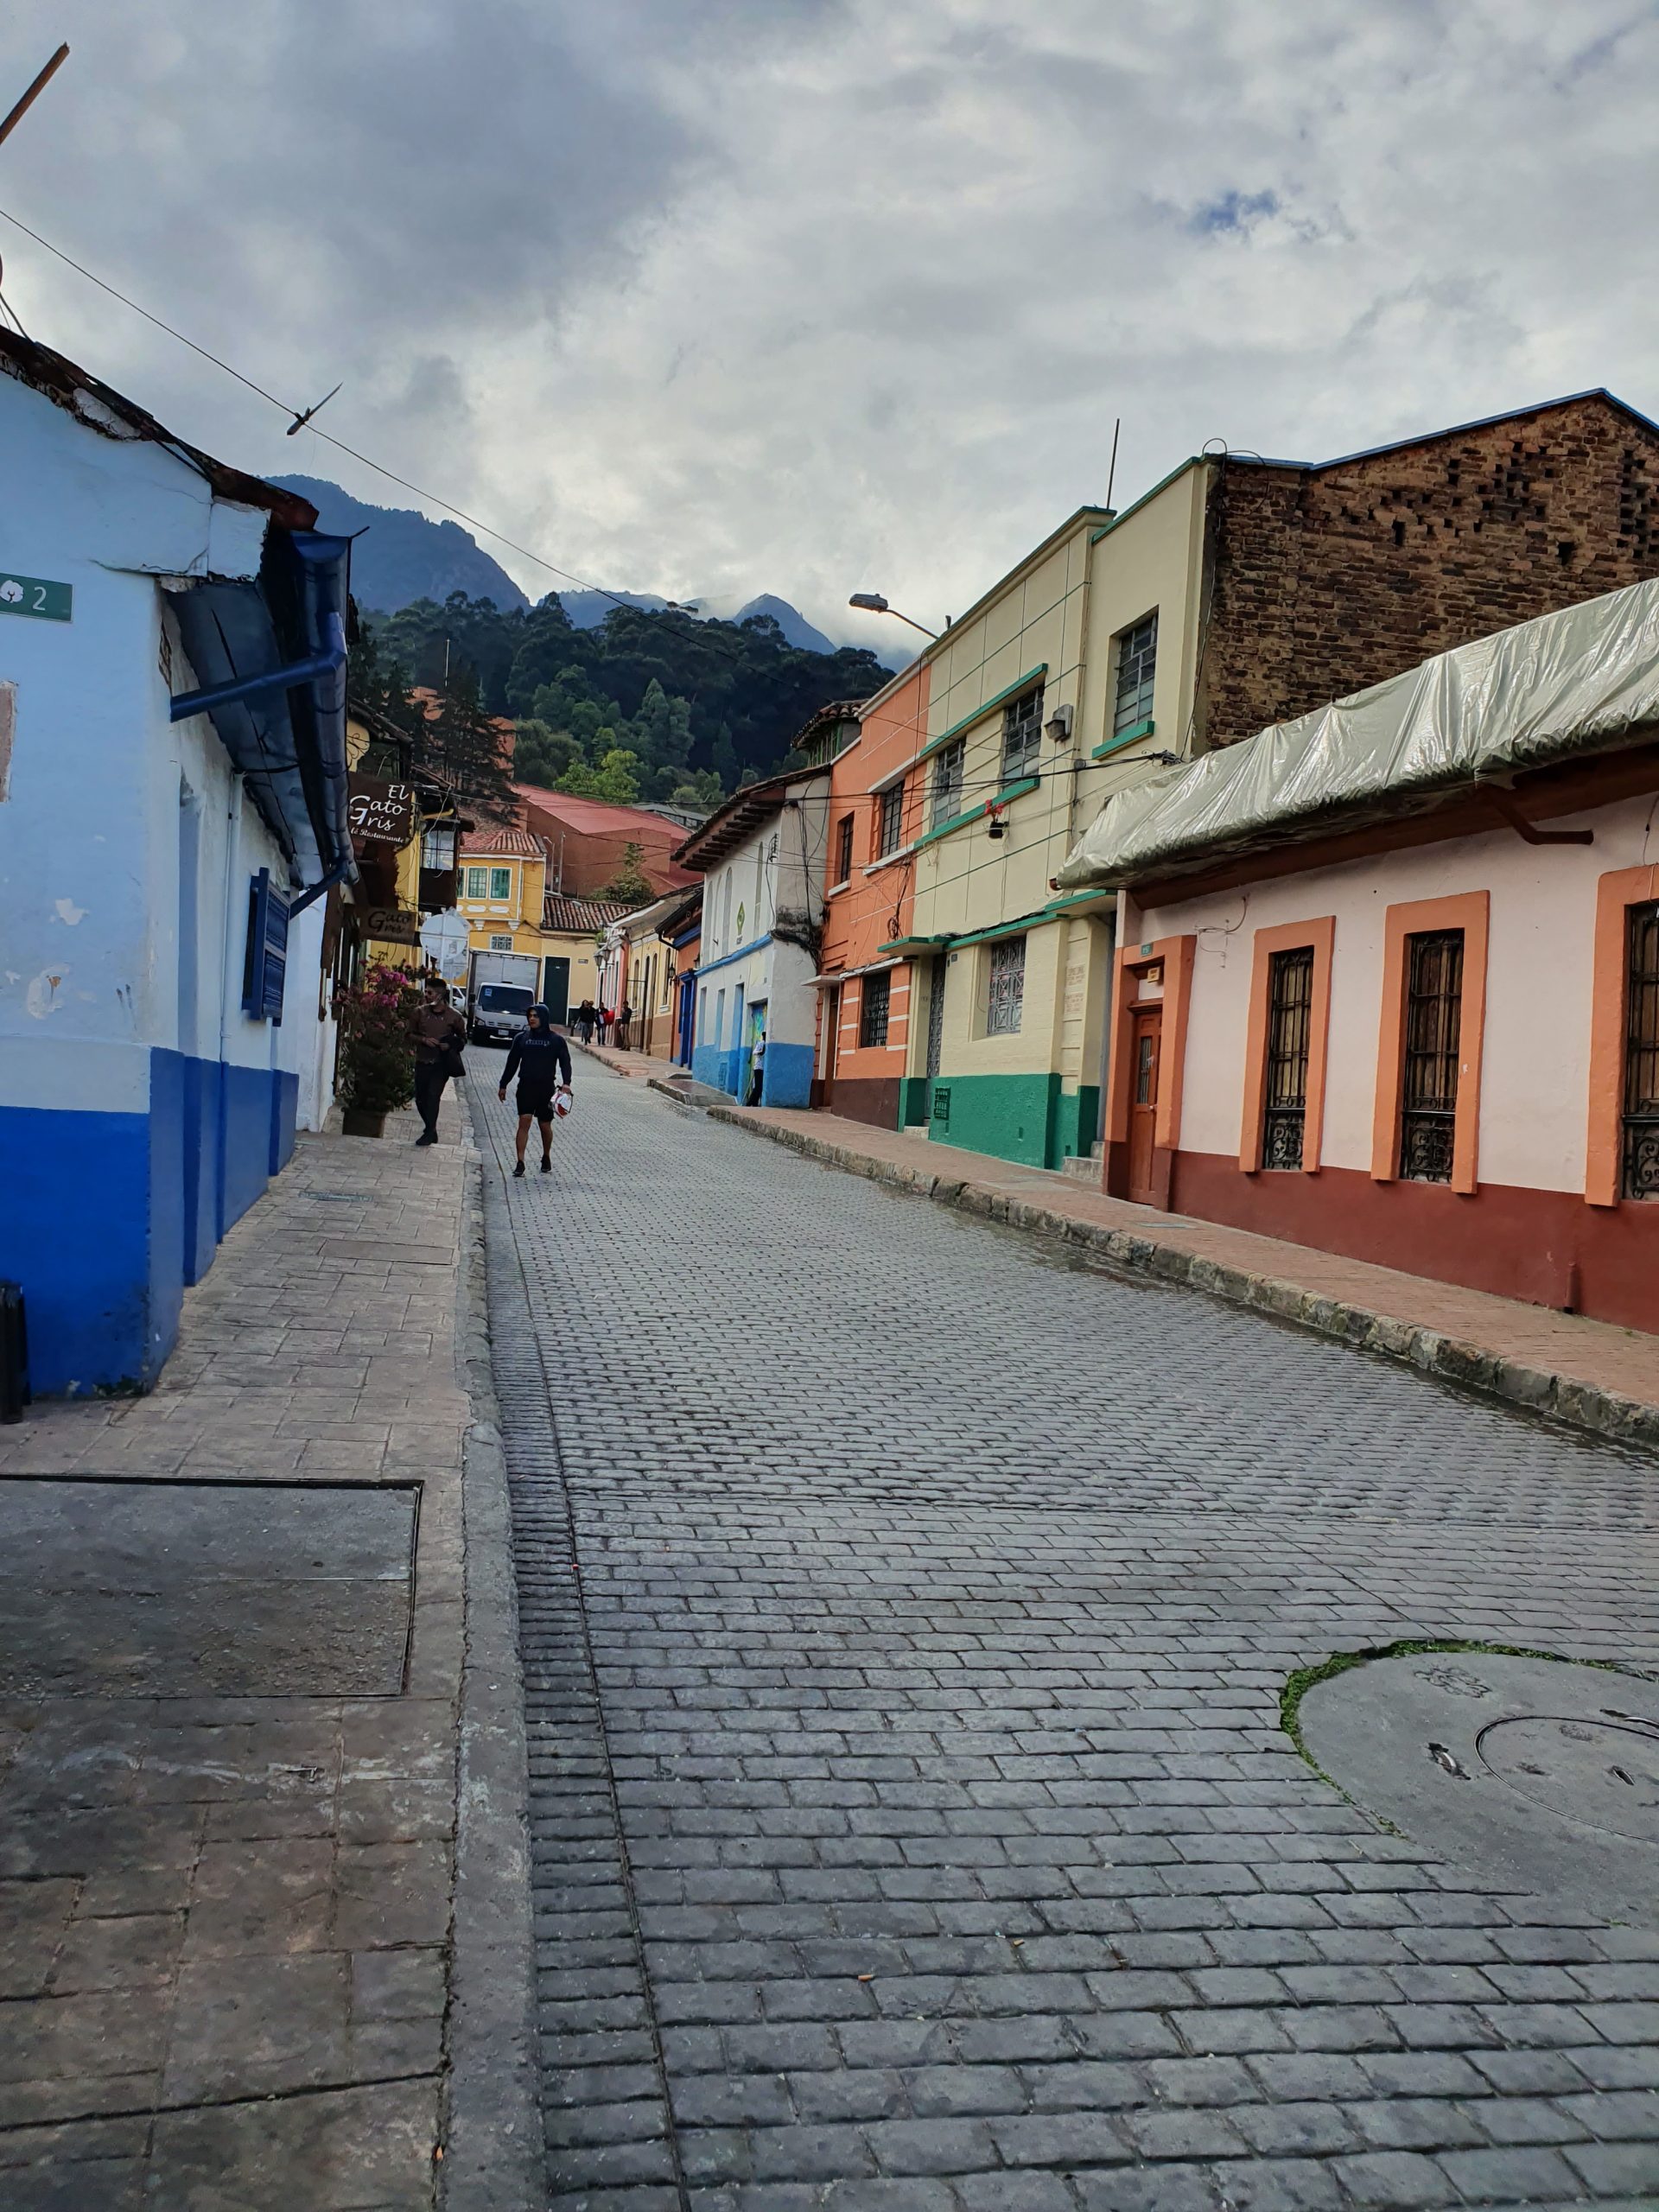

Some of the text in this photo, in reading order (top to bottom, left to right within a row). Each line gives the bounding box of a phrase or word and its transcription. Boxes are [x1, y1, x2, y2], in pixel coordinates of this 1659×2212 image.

[388, 784, 410, 800] El
[349, 795, 408, 816] Gato
[359, 830, 404, 843] Restaurante
